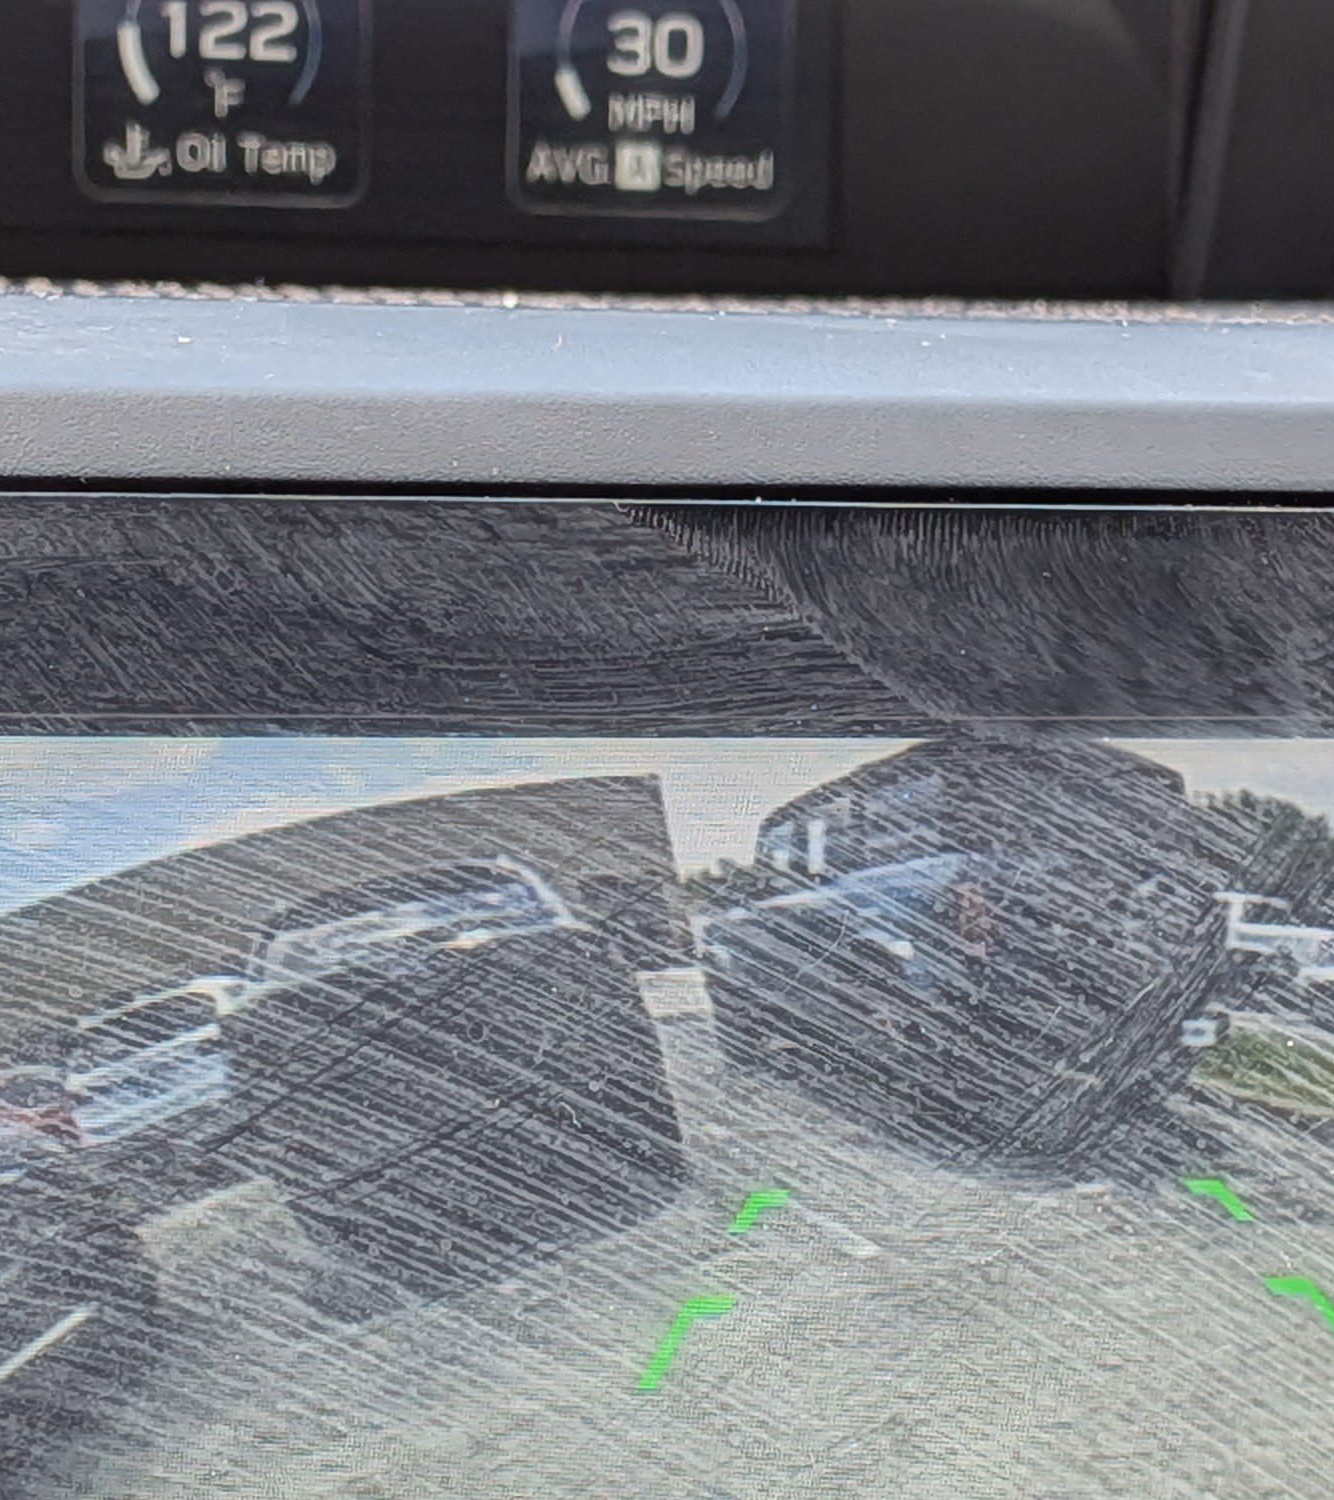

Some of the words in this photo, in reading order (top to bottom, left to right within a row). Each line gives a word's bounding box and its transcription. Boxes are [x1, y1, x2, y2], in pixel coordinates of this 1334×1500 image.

[160, 0, 300, 62] 122
[606, 10, 705, 78] 30
[608, 92, 696, 135] MPH
[175, 131, 227, 174] Oil
[236, 130, 337, 186] Temp
[525, 140, 611, 186] AVG
